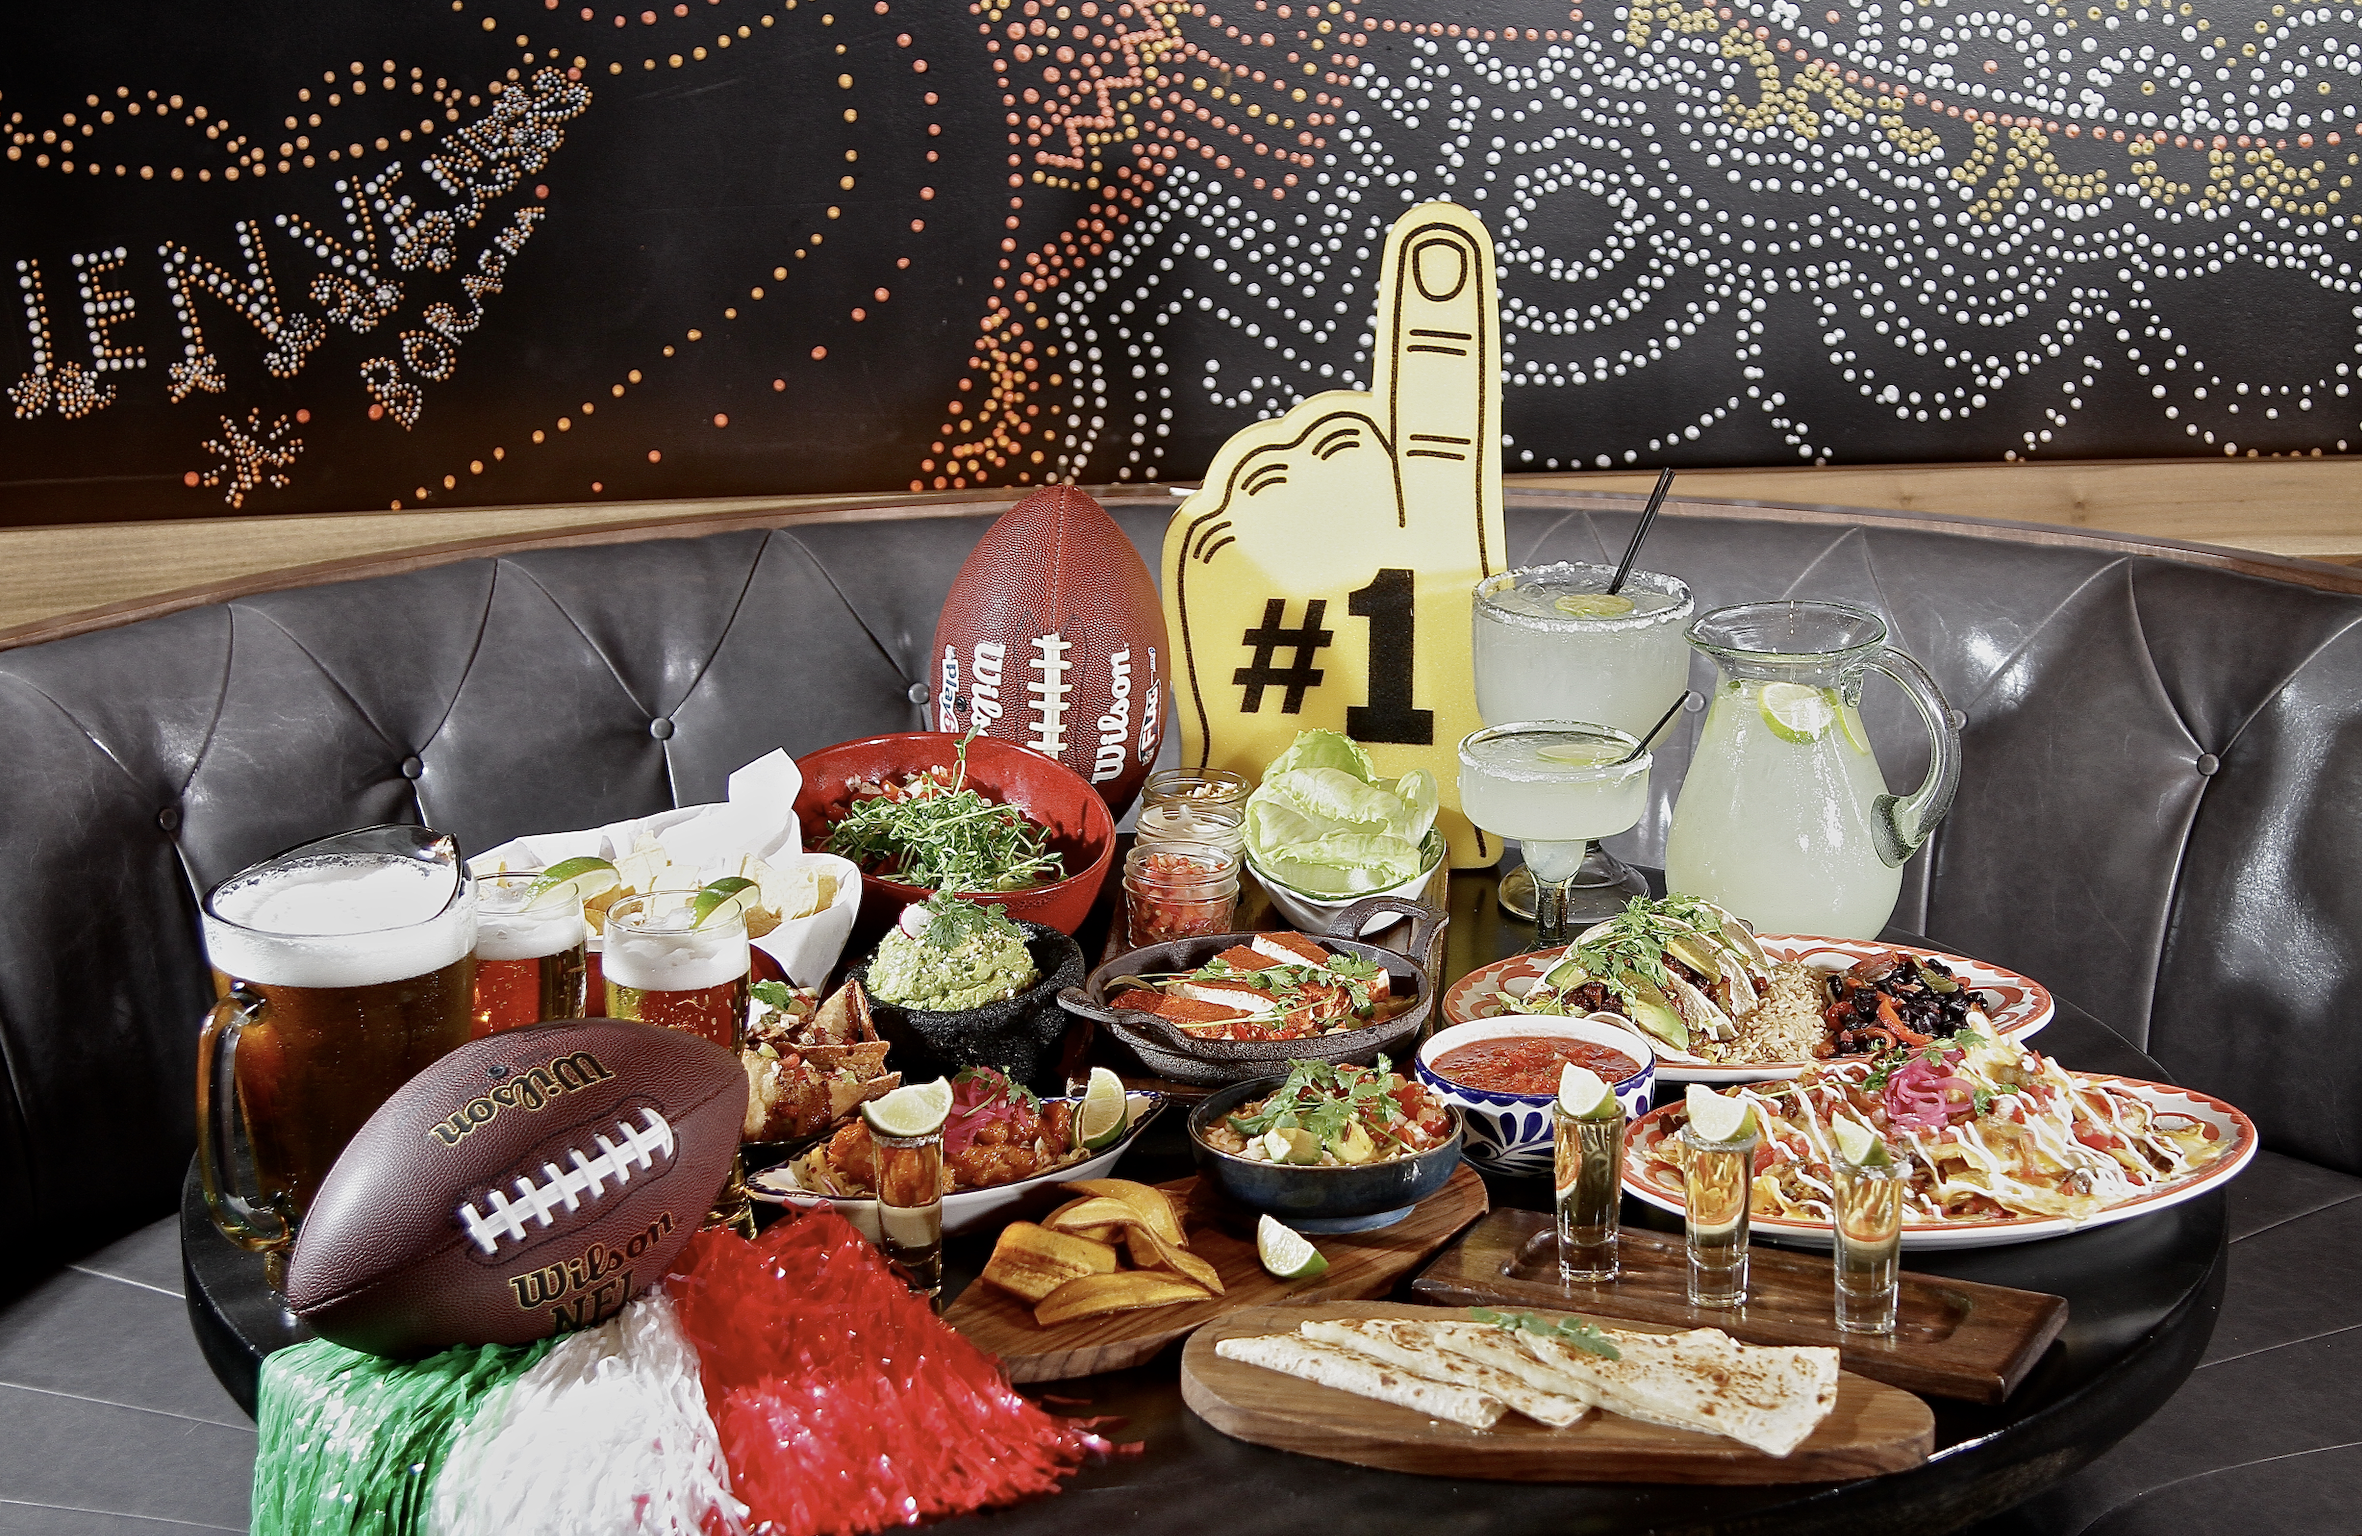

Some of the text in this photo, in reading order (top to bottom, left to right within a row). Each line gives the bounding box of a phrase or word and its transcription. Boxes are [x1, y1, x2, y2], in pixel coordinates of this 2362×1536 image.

[970, 641, 1006, 737] Wils
[1231, 567, 1434, 746] #1
[1090, 648, 1132, 784] Wilson
[1140, 685, 1160, 752] FLAG
[430, 1050, 617, 1147] Wilson
[508, 1210, 676, 1311] Wilson
[550, 1268, 642, 1336] NFL
